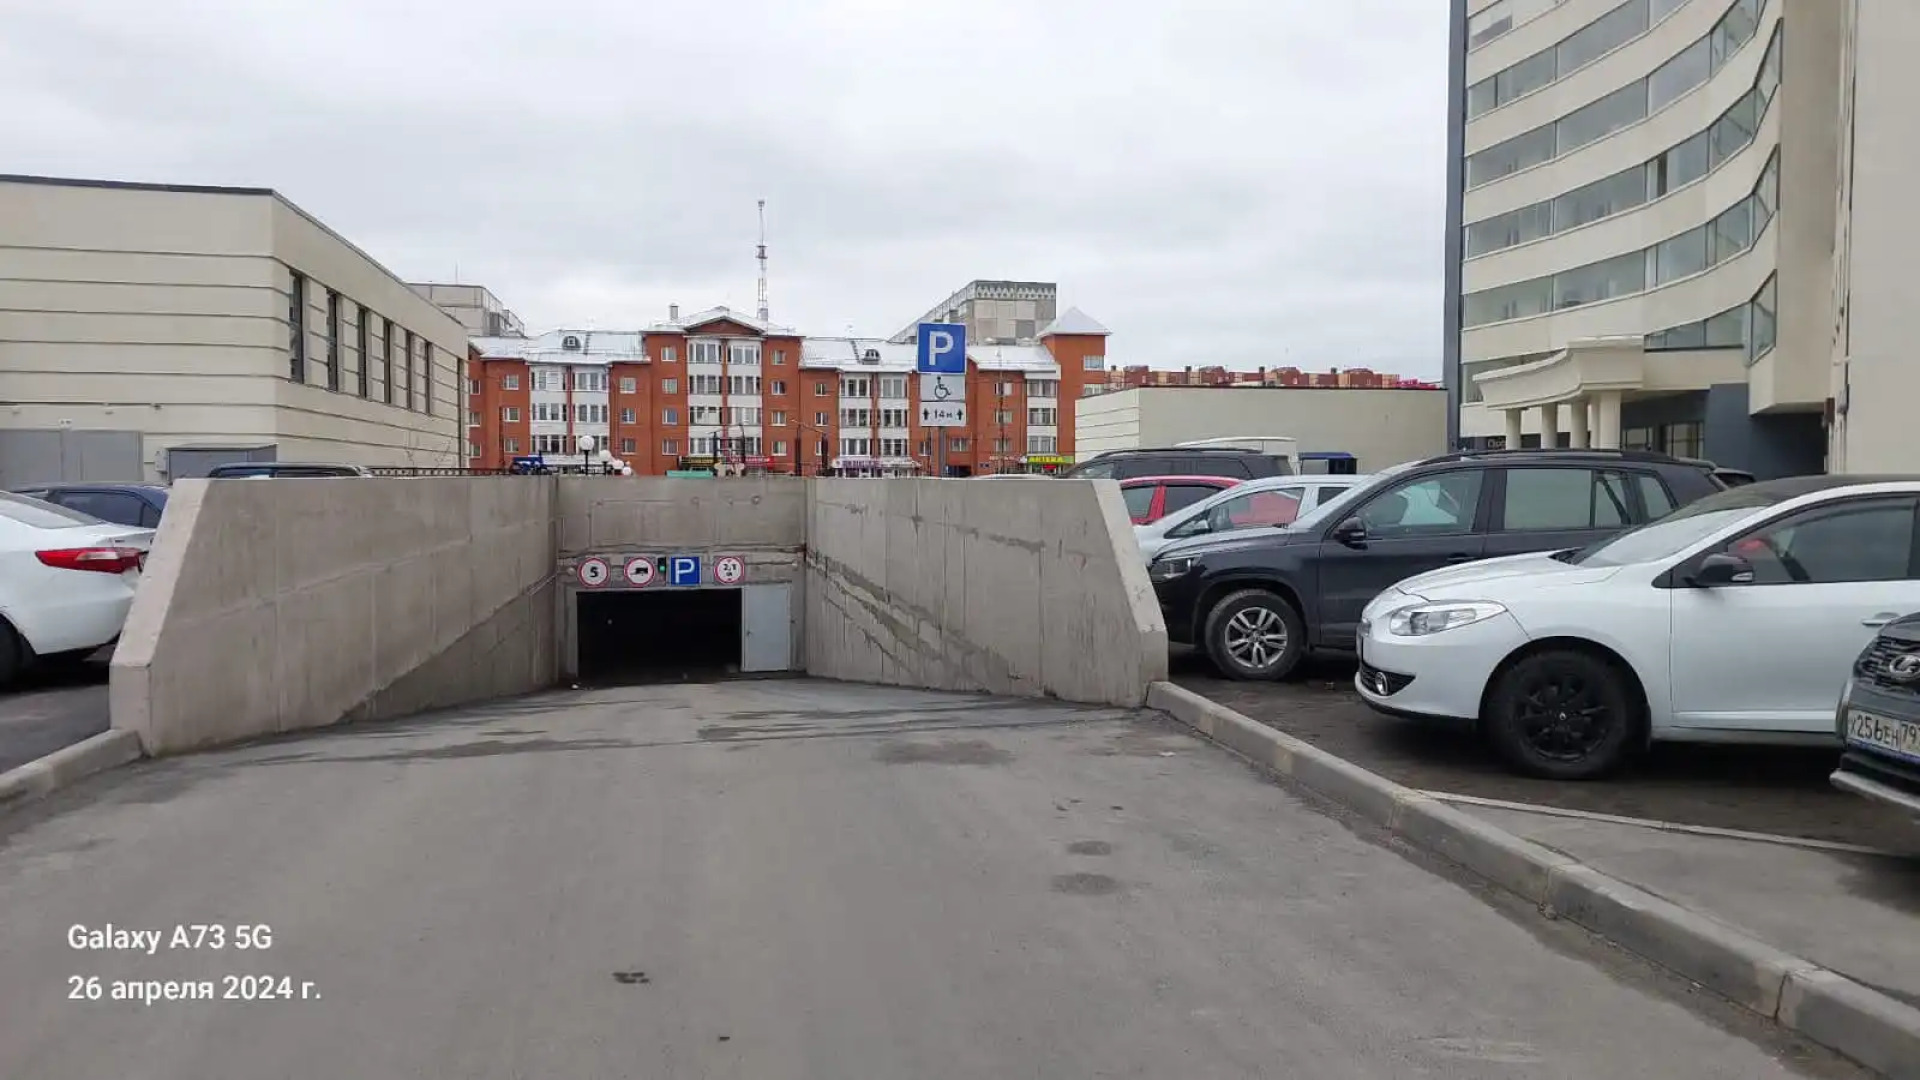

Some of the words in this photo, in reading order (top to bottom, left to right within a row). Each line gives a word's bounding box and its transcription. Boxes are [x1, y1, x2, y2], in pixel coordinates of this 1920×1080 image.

[929, 331, 954, 366] P
[590, 566, 598, 578] 5
[675, 558, 695, 583] P
